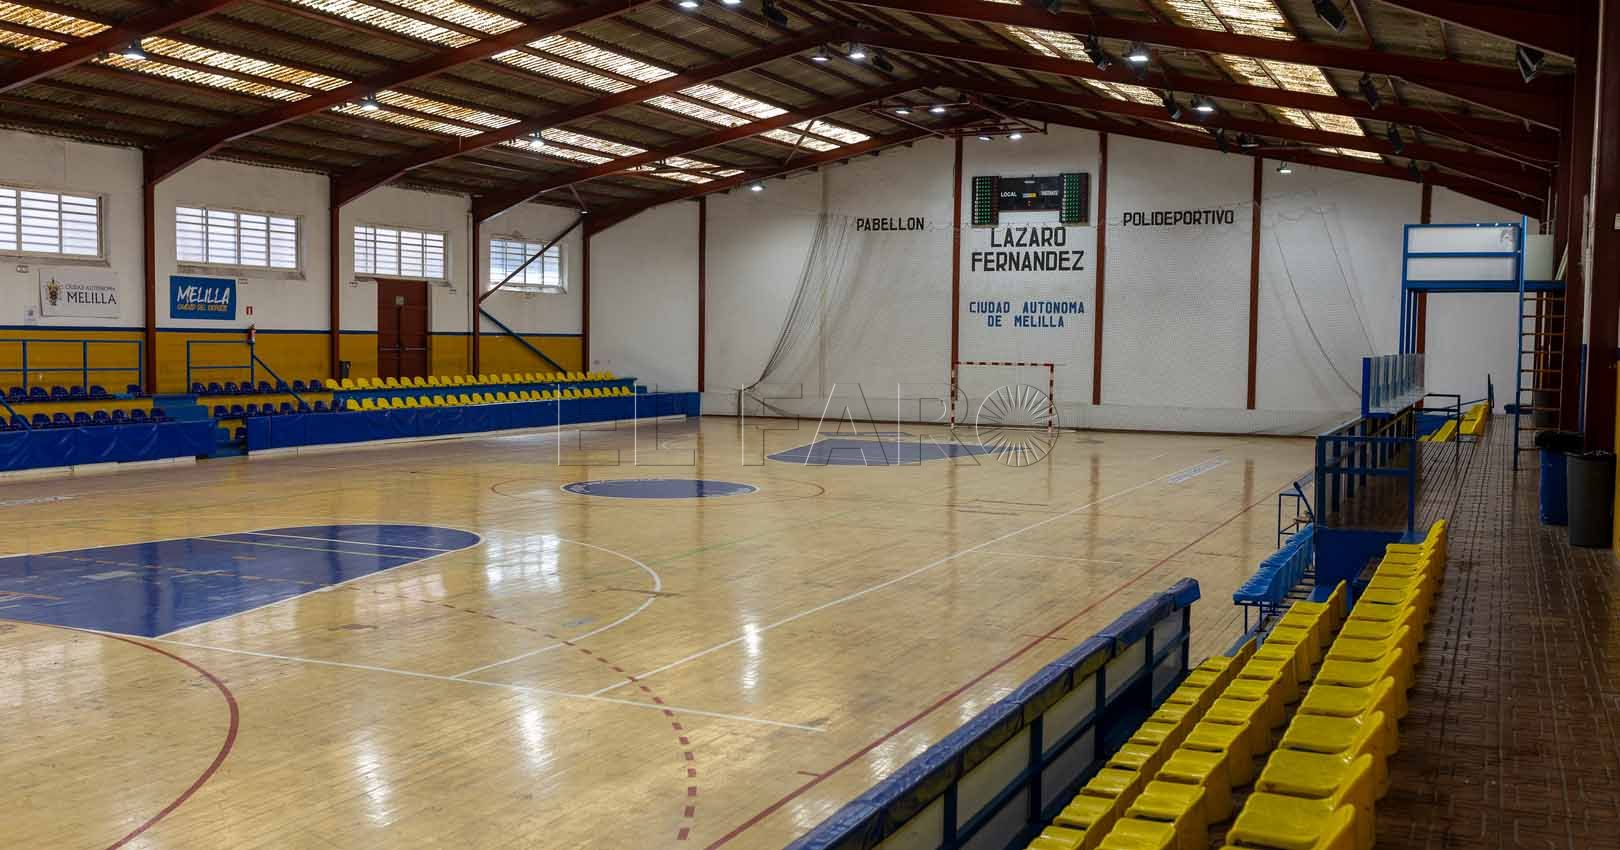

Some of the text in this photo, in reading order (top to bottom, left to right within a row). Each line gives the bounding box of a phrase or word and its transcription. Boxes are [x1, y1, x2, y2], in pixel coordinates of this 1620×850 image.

[1000, 190, 1018, 198] LOCAL
[856, 217, 925, 232] PABELLON
[1123, 210, 1234, 226] POLIDEPORTIVO
[990, 226, 1067, 248] LAZARO
[971, 250, 1085, 272] FERNANDEZ
[66, 291, 117, 305] MELILLA
[176, 285, 231, 305] MELILLA
[969, 301, 1085, 314] CIUDAD AUTONOMA
[987, 315, 1065, 328] DE MELILLA
